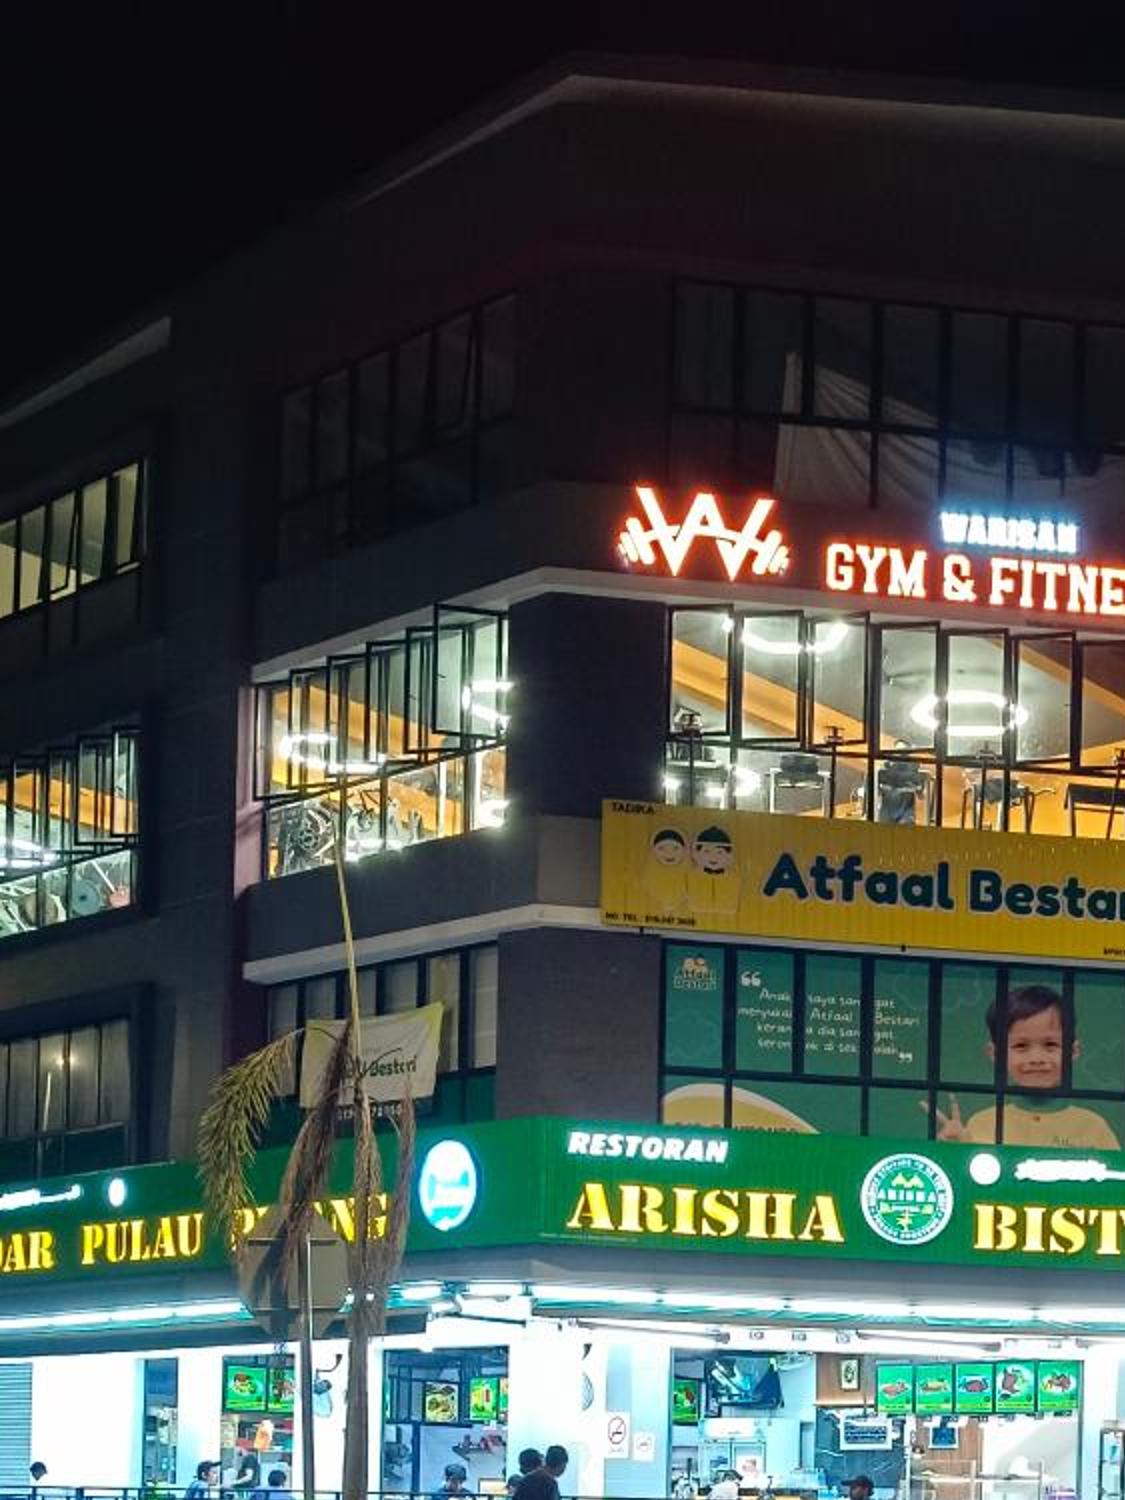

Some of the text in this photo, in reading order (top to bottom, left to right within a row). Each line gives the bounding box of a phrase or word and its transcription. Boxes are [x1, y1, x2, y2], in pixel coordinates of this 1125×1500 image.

[940, 512, 1078, 552] WARISAN
[826, 543, 926, 601] GYM
[943, 559, 976, 602] &
[763, 853, 954, 911] Atfaal
[567, 1131, 729, 1163] RESTORAN
[81, 1212, 204, 1265] PULAU
[566, 1183, 846, 1243] ARISHA
